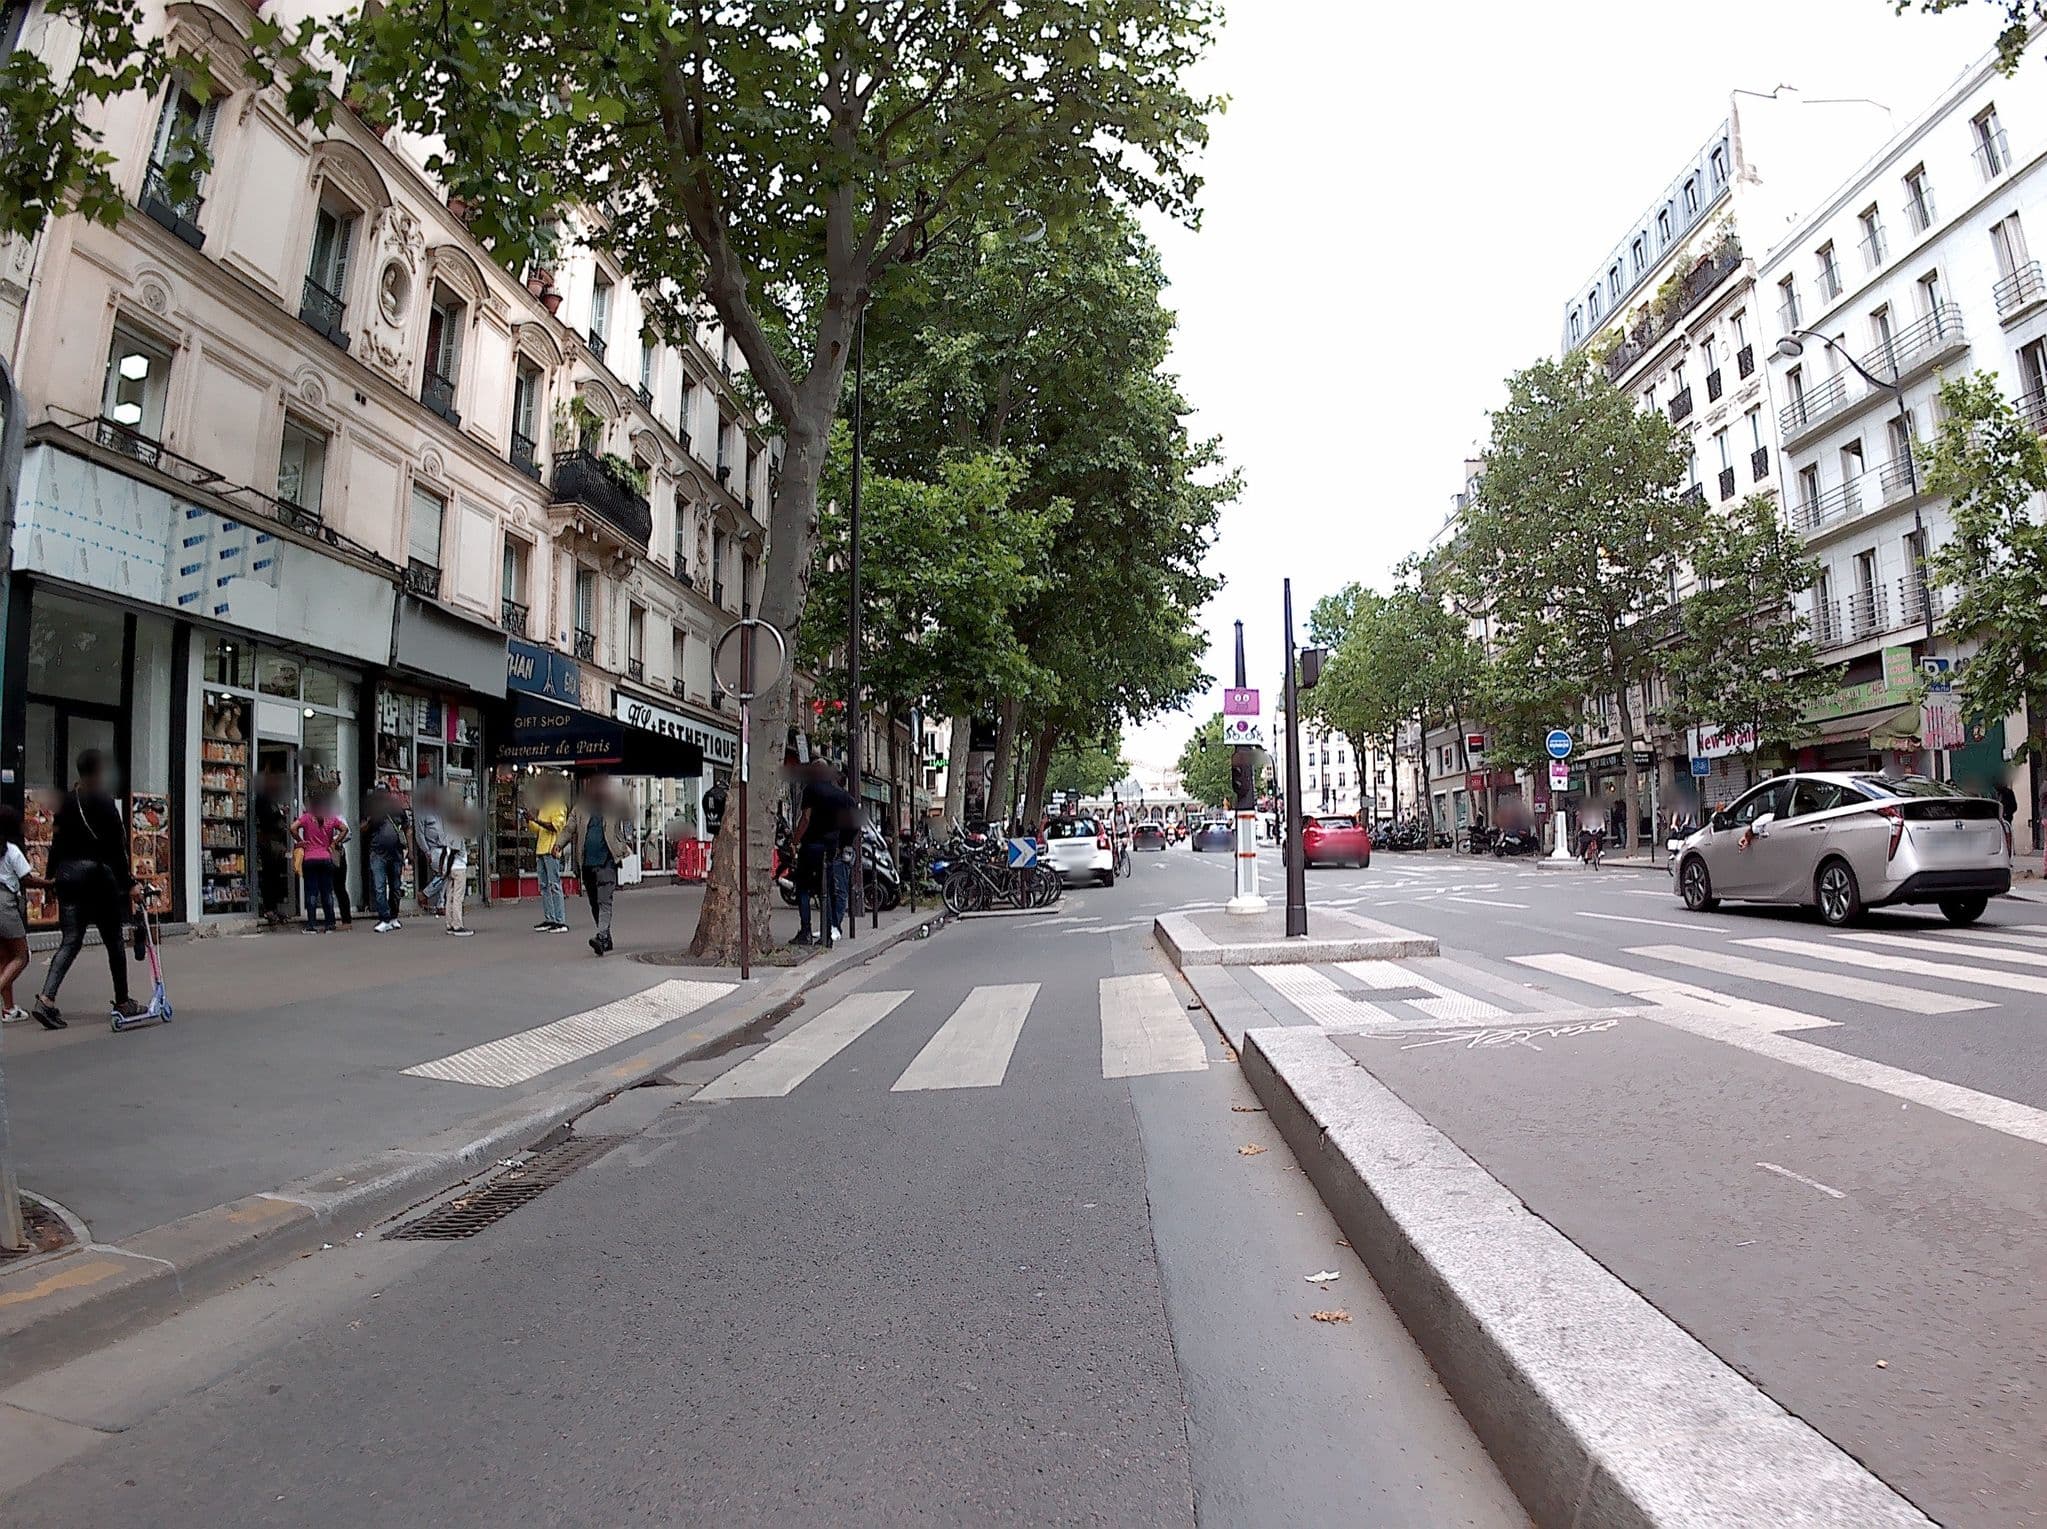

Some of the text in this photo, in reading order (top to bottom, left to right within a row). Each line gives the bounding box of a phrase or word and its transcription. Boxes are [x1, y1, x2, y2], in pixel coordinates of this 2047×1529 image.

[508, 652, 534, 681] HAN
[514, 715, 571, 728] GIFT SHOP
[495, 739, 611, 758] Souvenir de Paris
[659, 718, 737, 760] ESTHETIQUE
